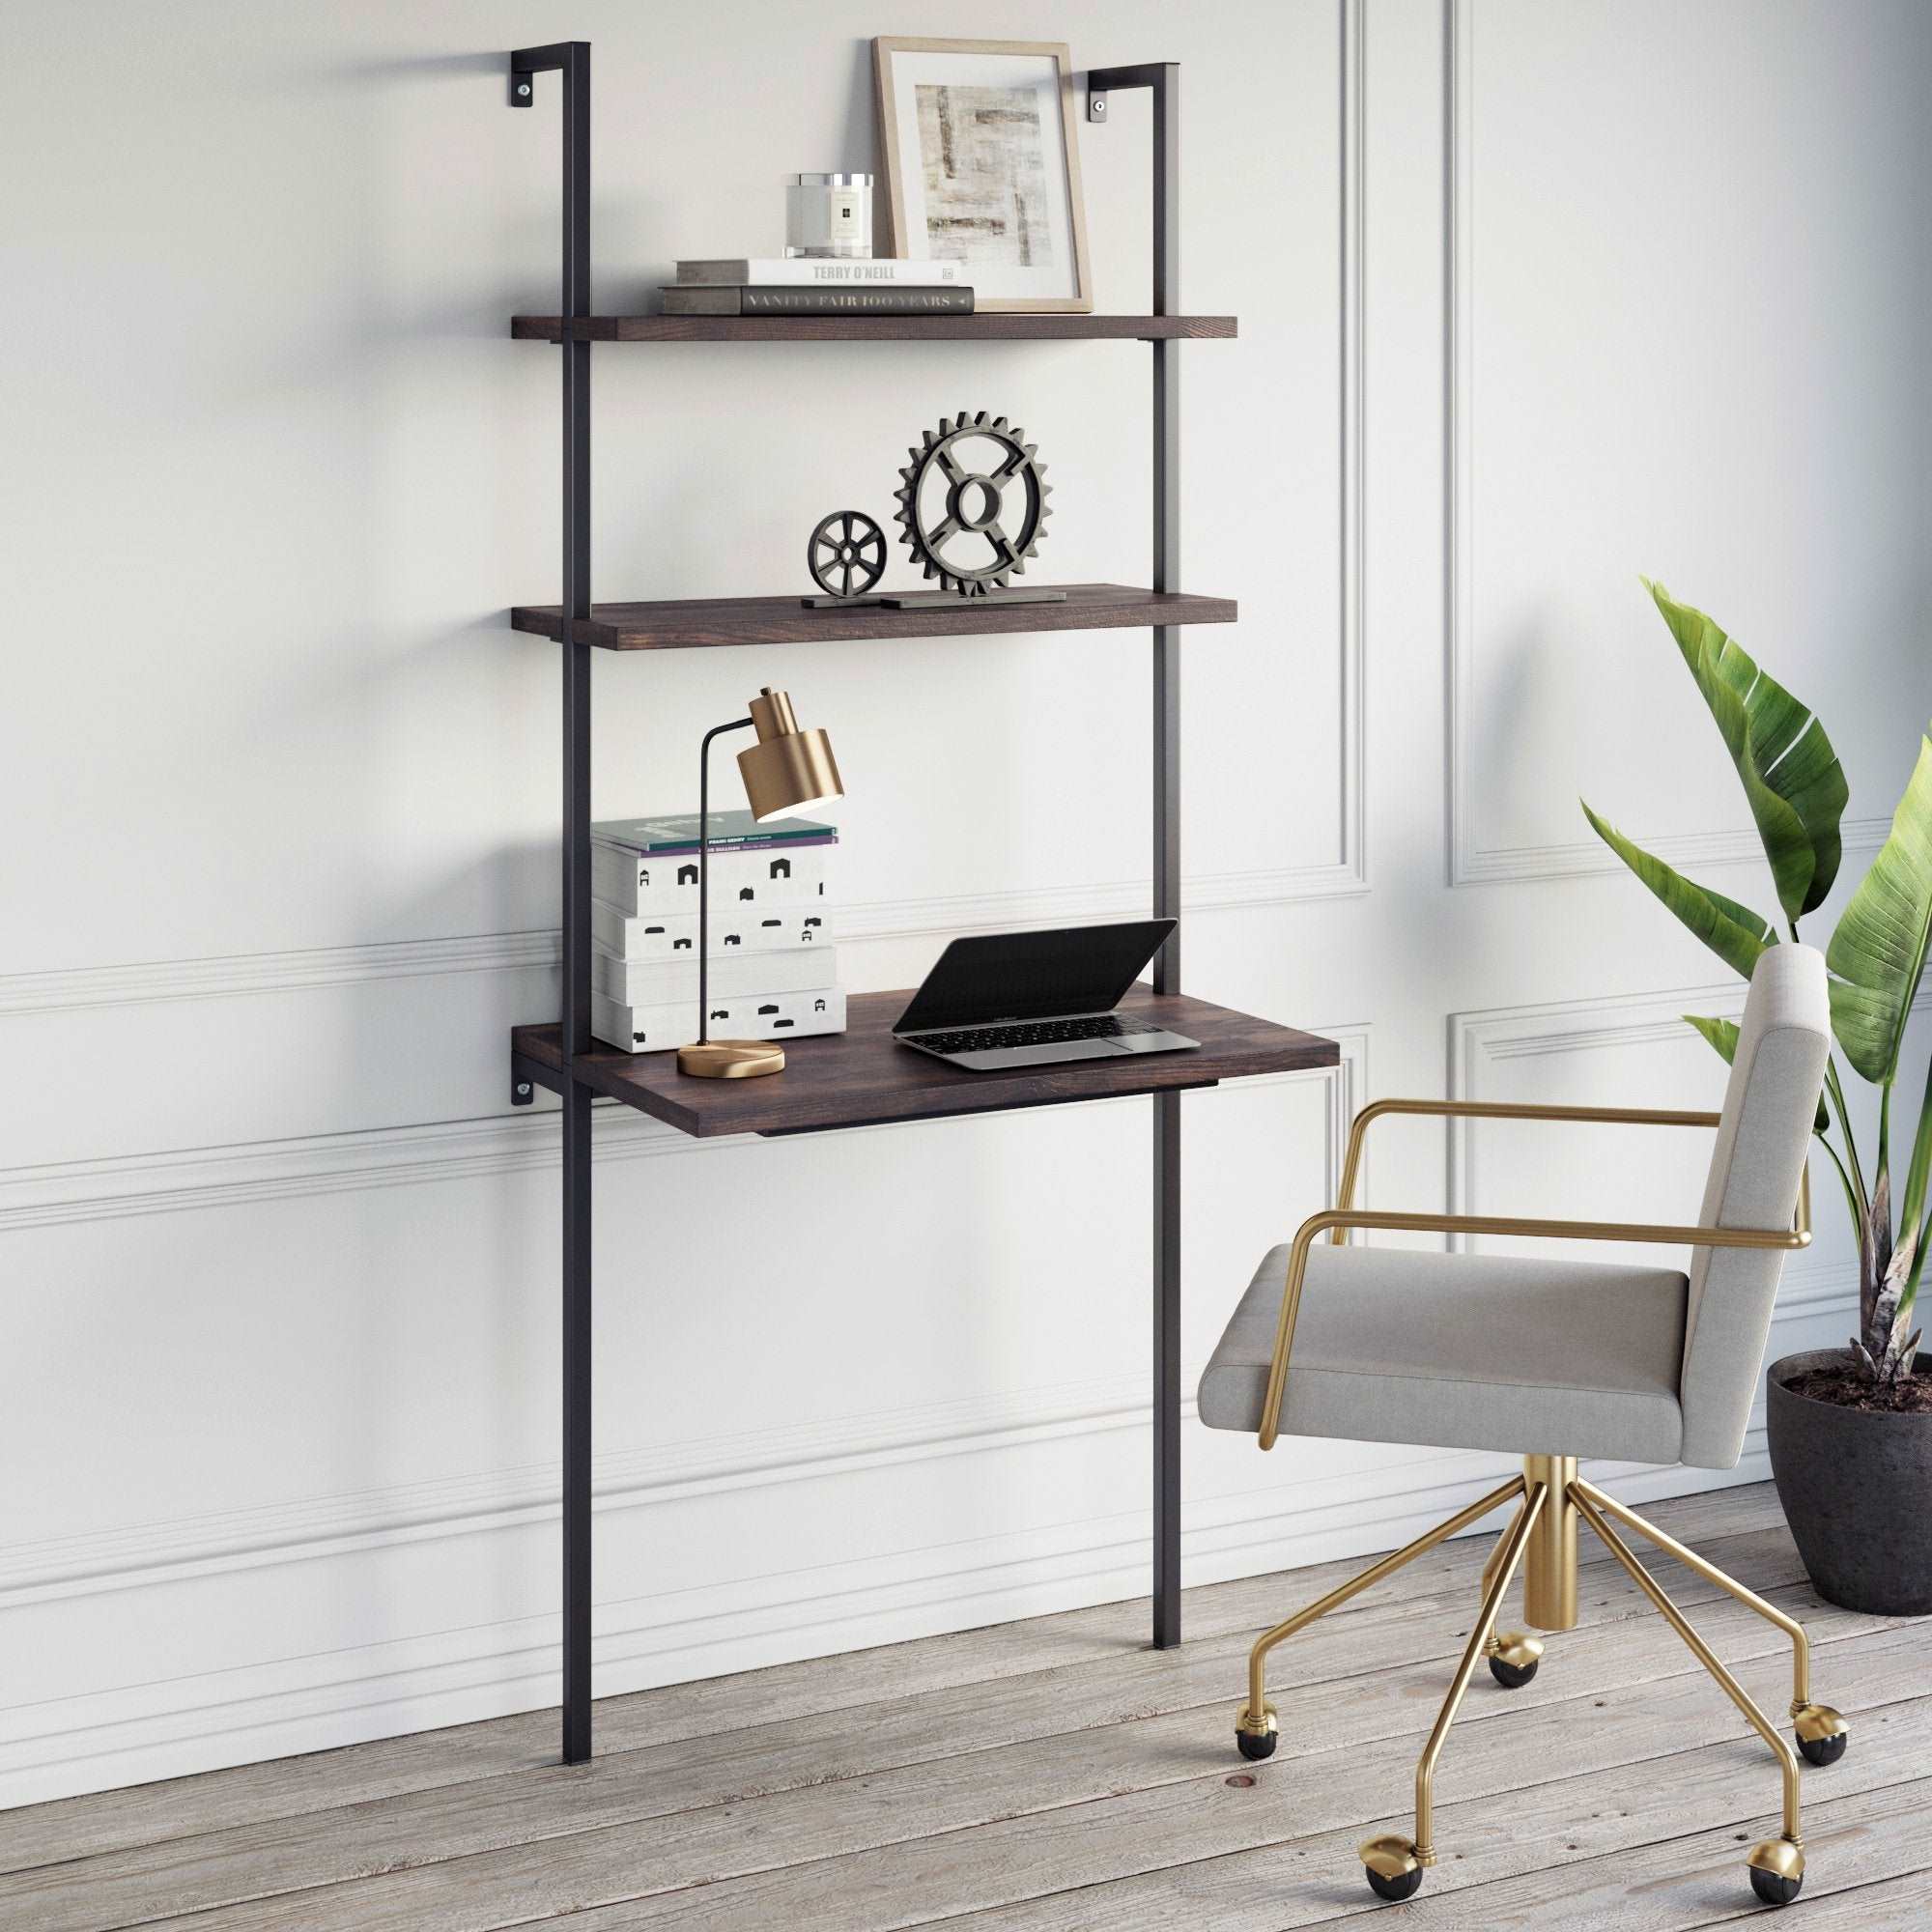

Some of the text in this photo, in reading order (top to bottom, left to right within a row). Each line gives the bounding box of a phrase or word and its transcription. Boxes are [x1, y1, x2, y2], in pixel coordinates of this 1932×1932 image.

[813, 266, 895, 279] TERRY O'NEILL
[749, 295, 811, 307] VANITY
[818, 295, 858, 307] FAIR
[896, 295, 951, 307] YEARS
